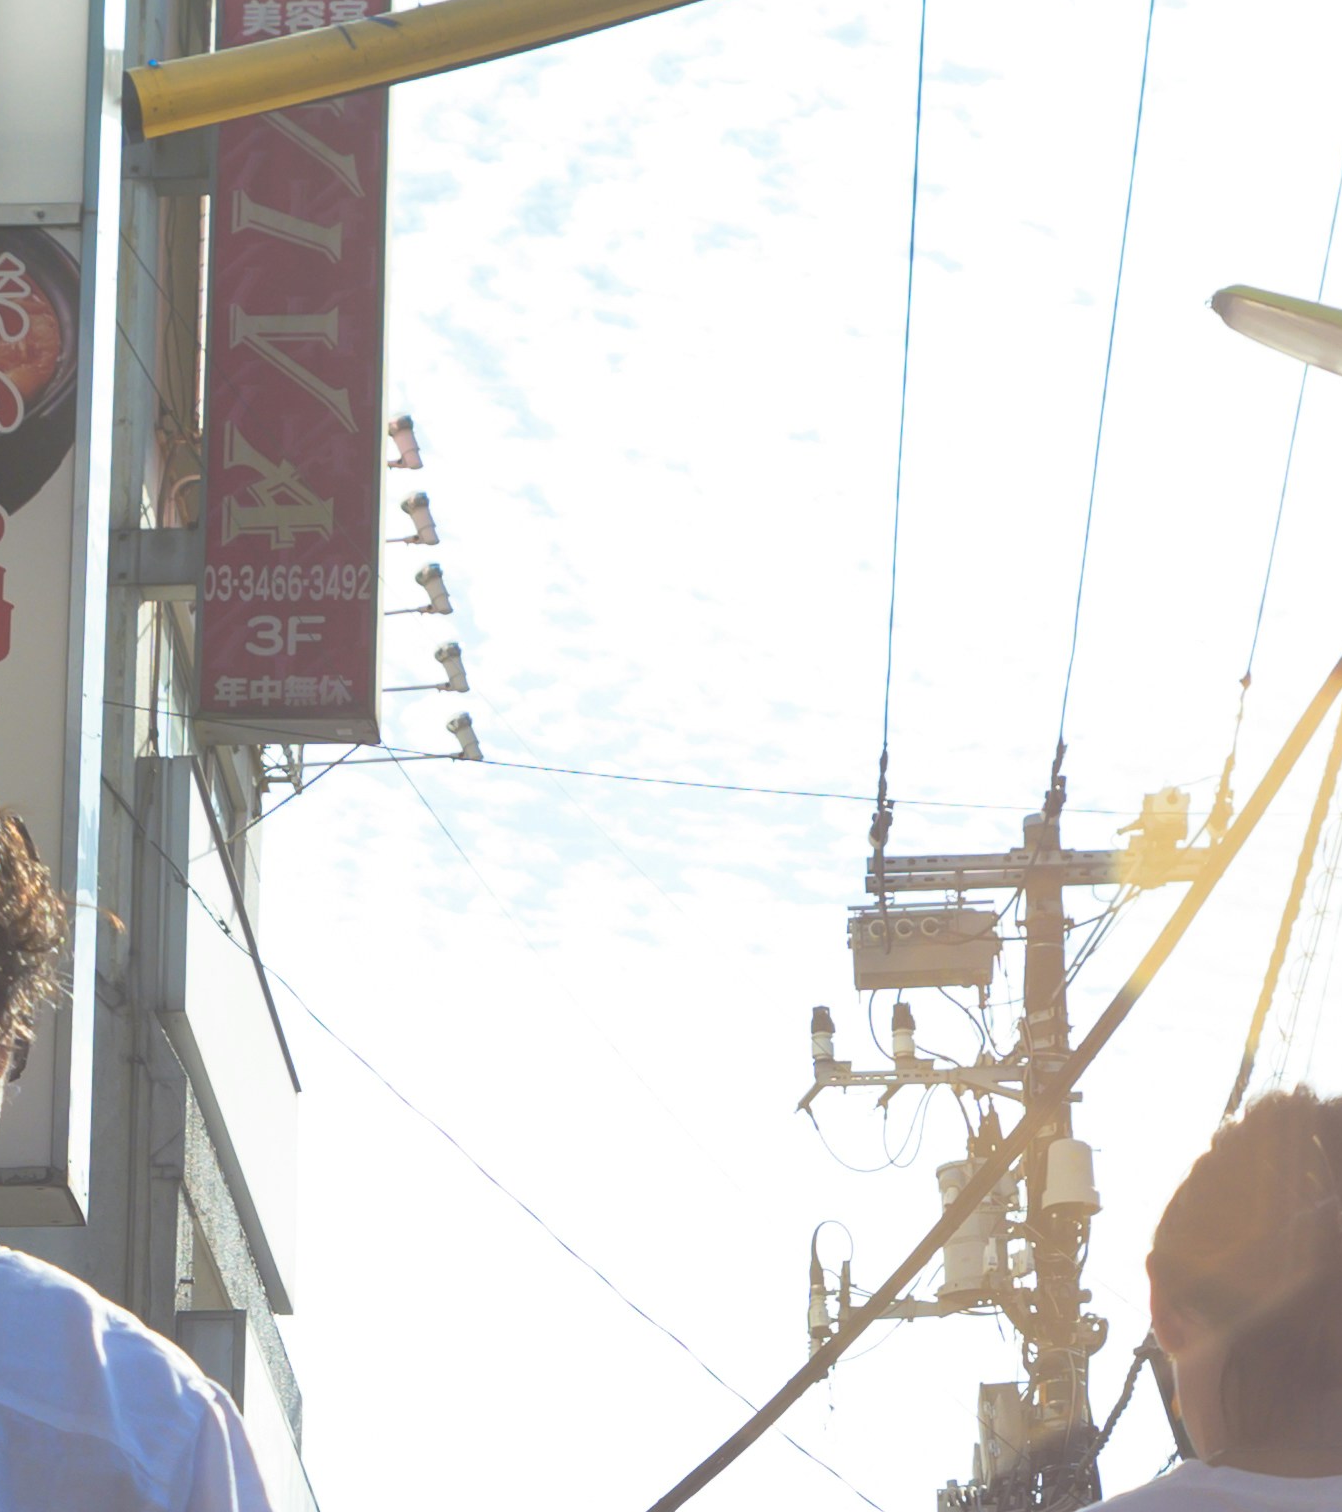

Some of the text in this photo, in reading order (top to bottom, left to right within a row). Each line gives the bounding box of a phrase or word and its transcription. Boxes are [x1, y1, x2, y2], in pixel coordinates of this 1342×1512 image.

[203, 563, 372, 603] 03-3466-3492
[245, 614, 327, 657] 3F
[214, 674, 353, 708] 年中無休
